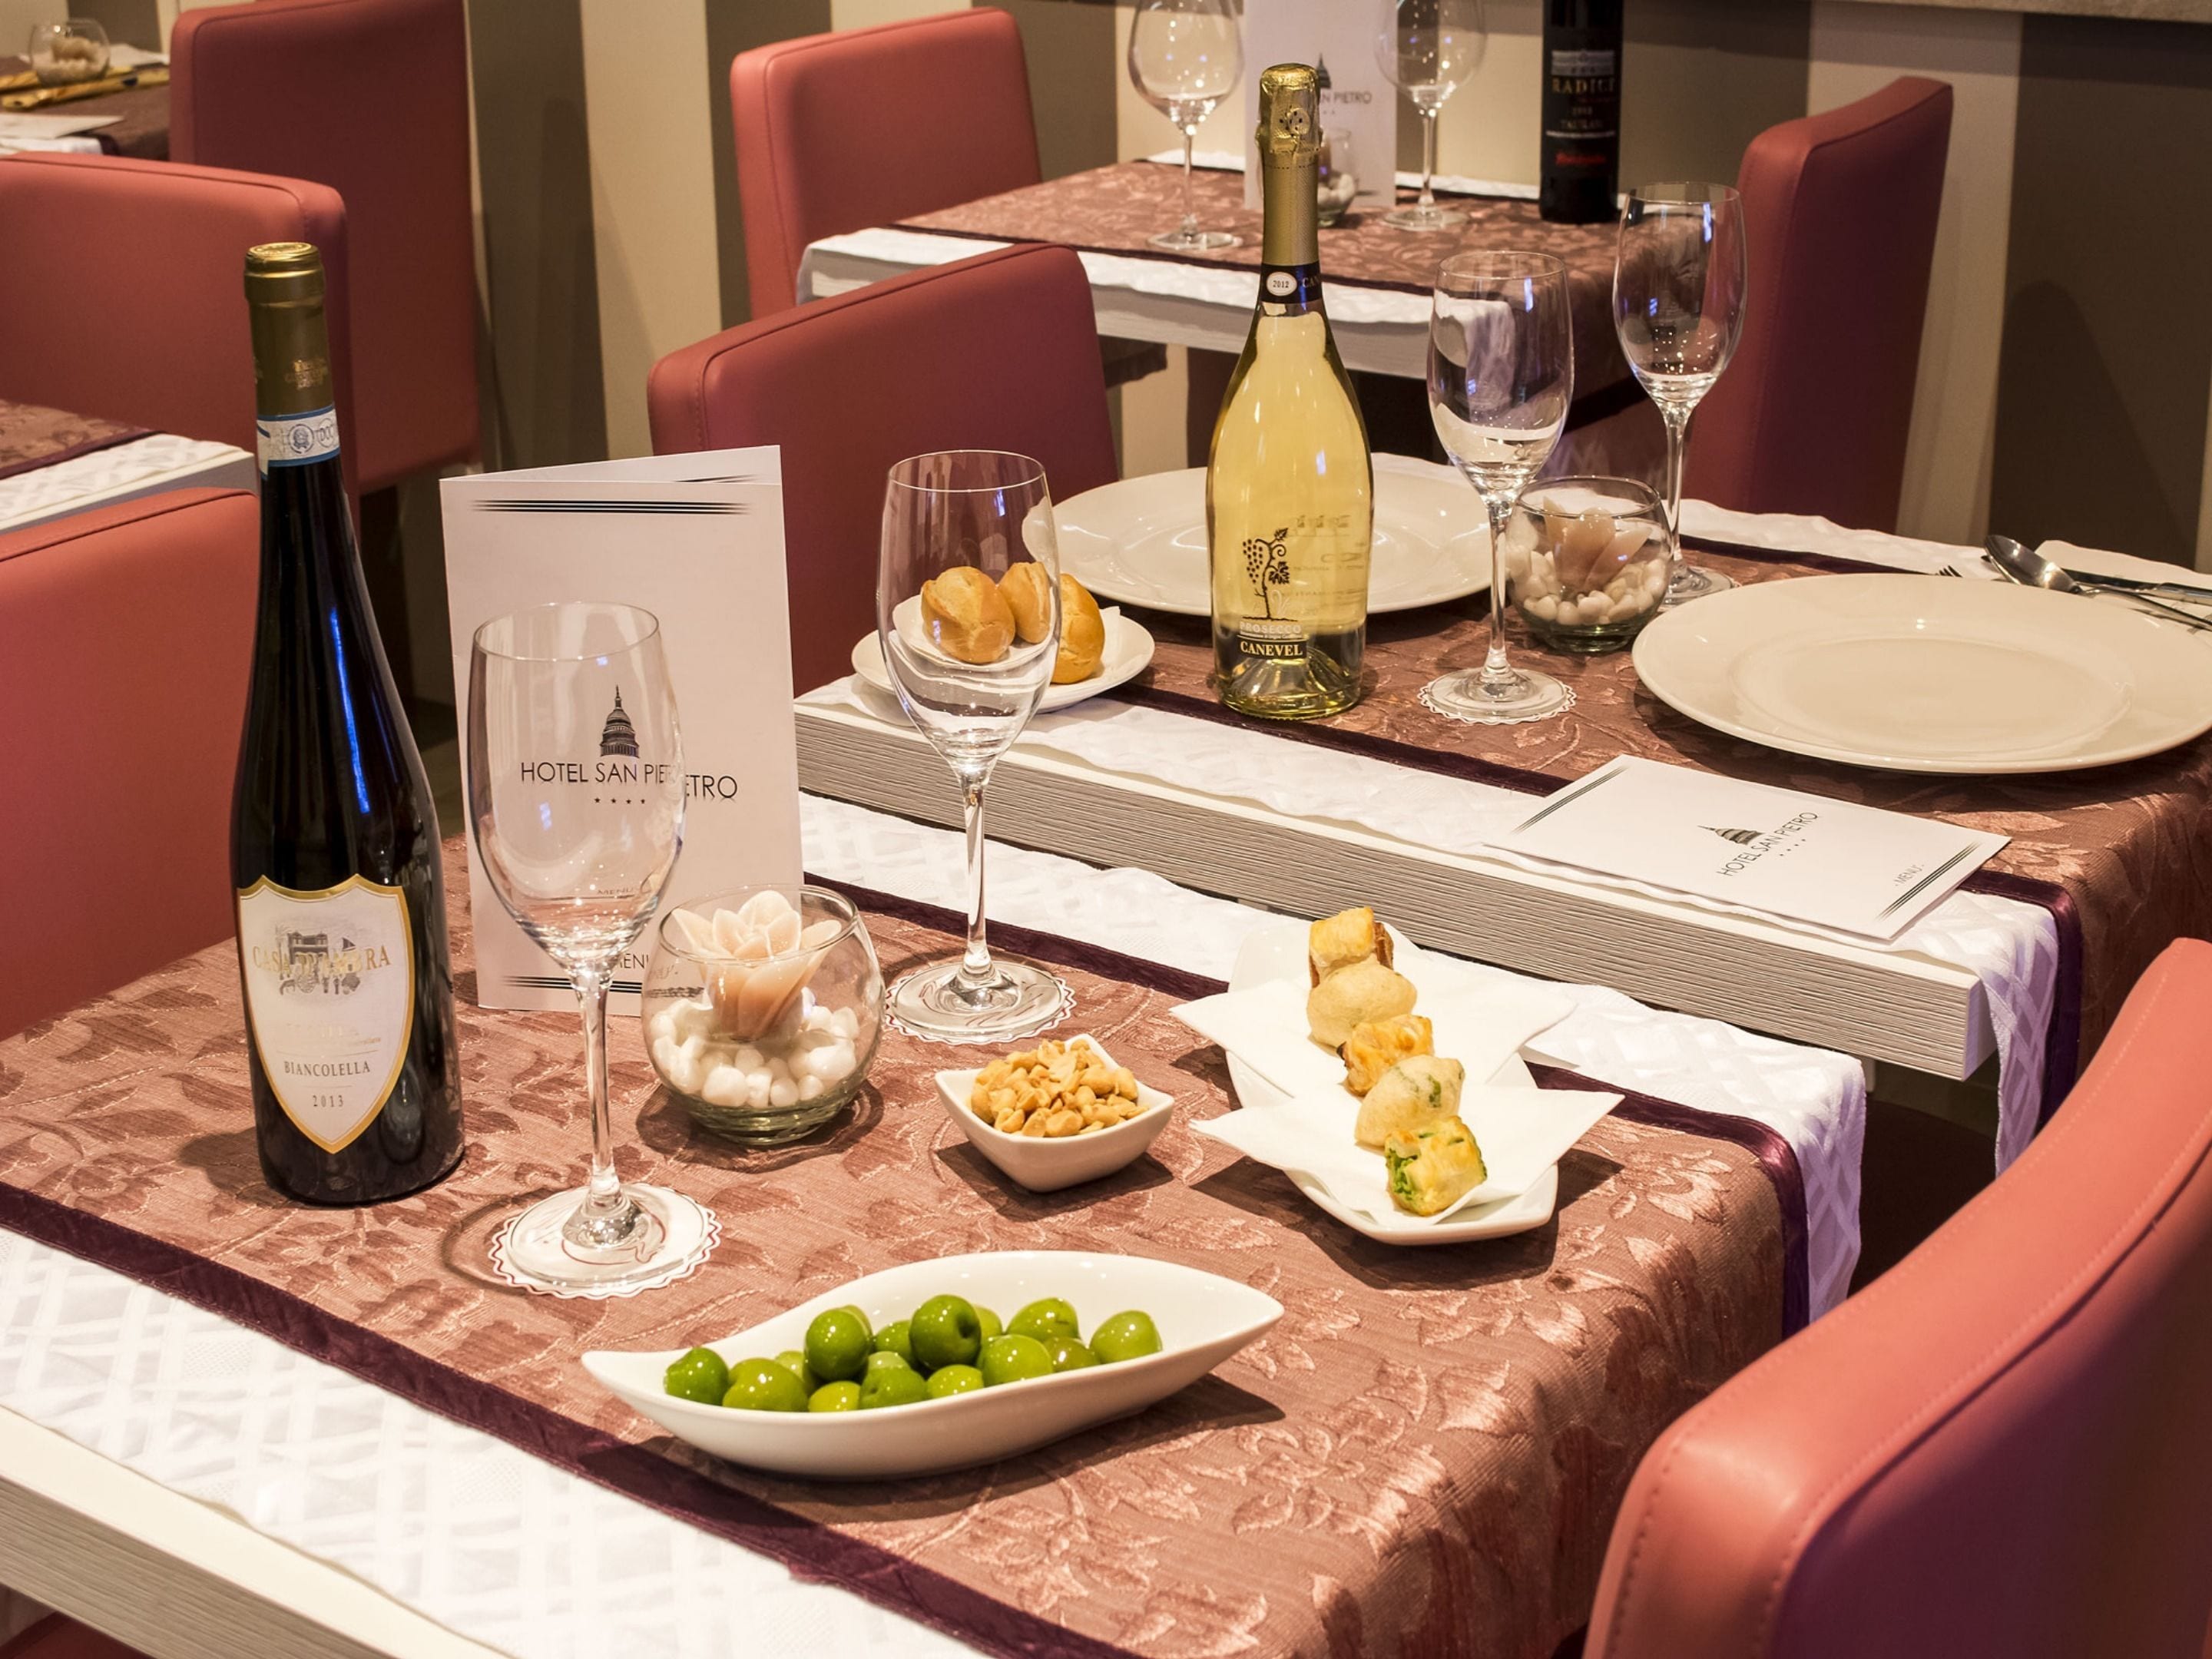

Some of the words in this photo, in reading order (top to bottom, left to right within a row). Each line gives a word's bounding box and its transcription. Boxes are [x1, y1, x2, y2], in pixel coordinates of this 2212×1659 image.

[1273, 280, 1290, 288] 2012
[1240, 621, 1302, 634] PROSECCO
[1240, 641, 1303, 657] CANEVEL
[521, 761, 588, 783] HOTEL
[594, 762, 637, 783] SAN
[1716, 852, 1762, 876] HOTEL
[1750, 834, 1783, 852] SAN
[1773, 812, 1818, 836] PIETRO
[283, 1060, 370, 1077] BIANCOLELLA
[312, 1094, 344, 1108] 2013
